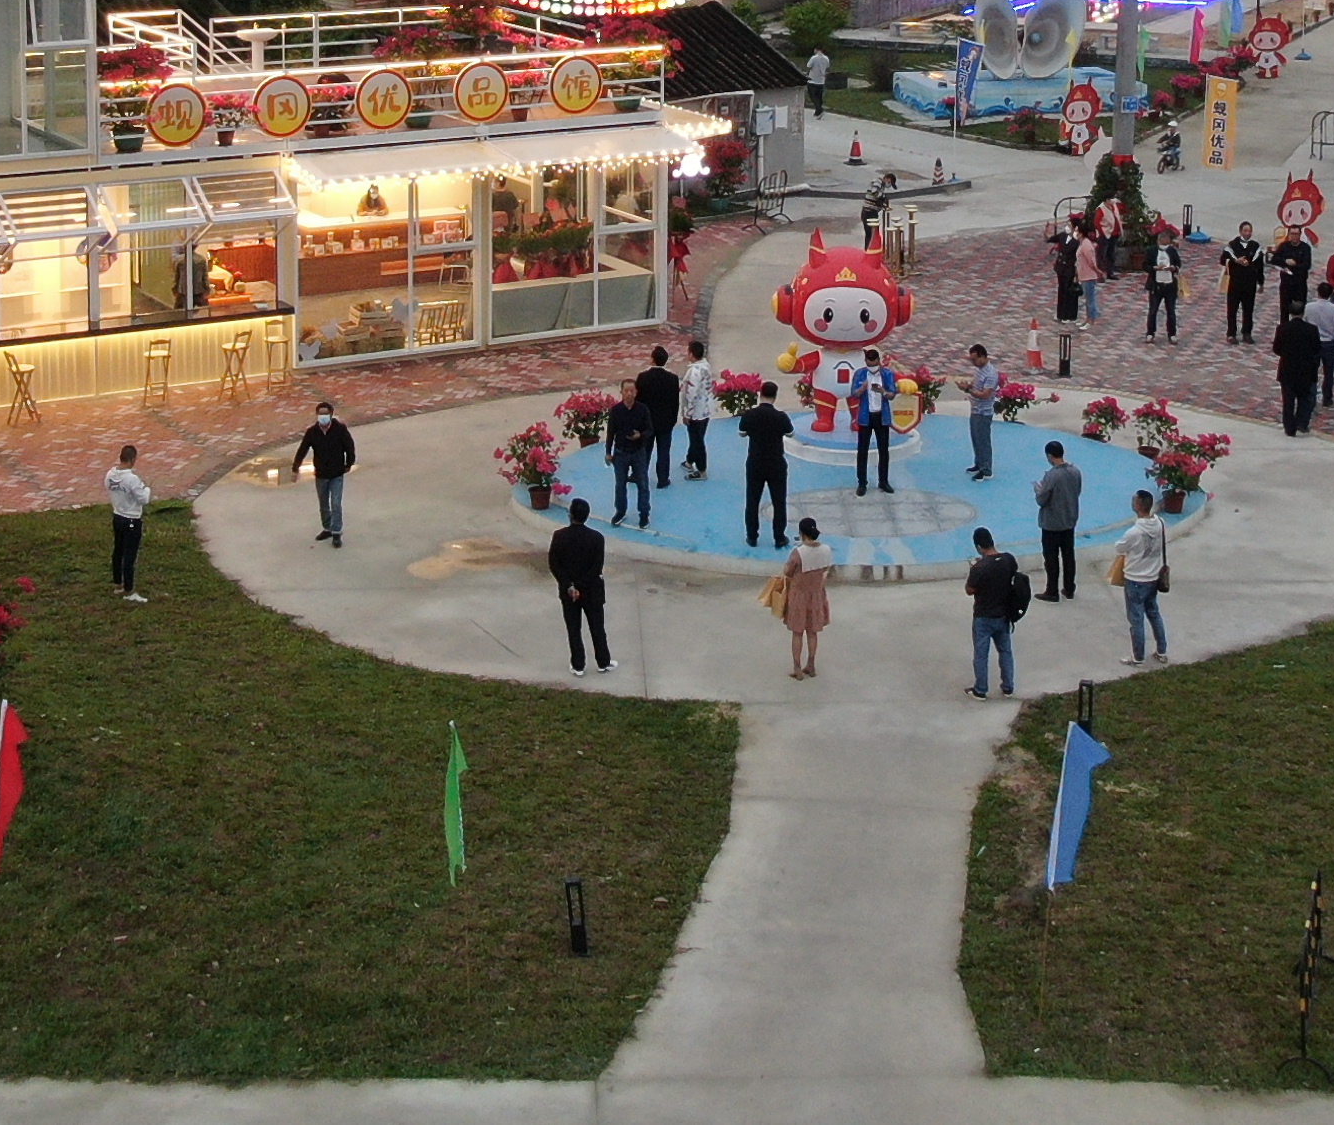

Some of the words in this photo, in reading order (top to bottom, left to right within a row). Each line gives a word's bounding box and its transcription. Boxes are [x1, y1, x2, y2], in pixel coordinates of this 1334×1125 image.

[157, 67, 593, 131] 蚬冈优品馆
[1208, 100, 1228, 166] 蚬冈优品
